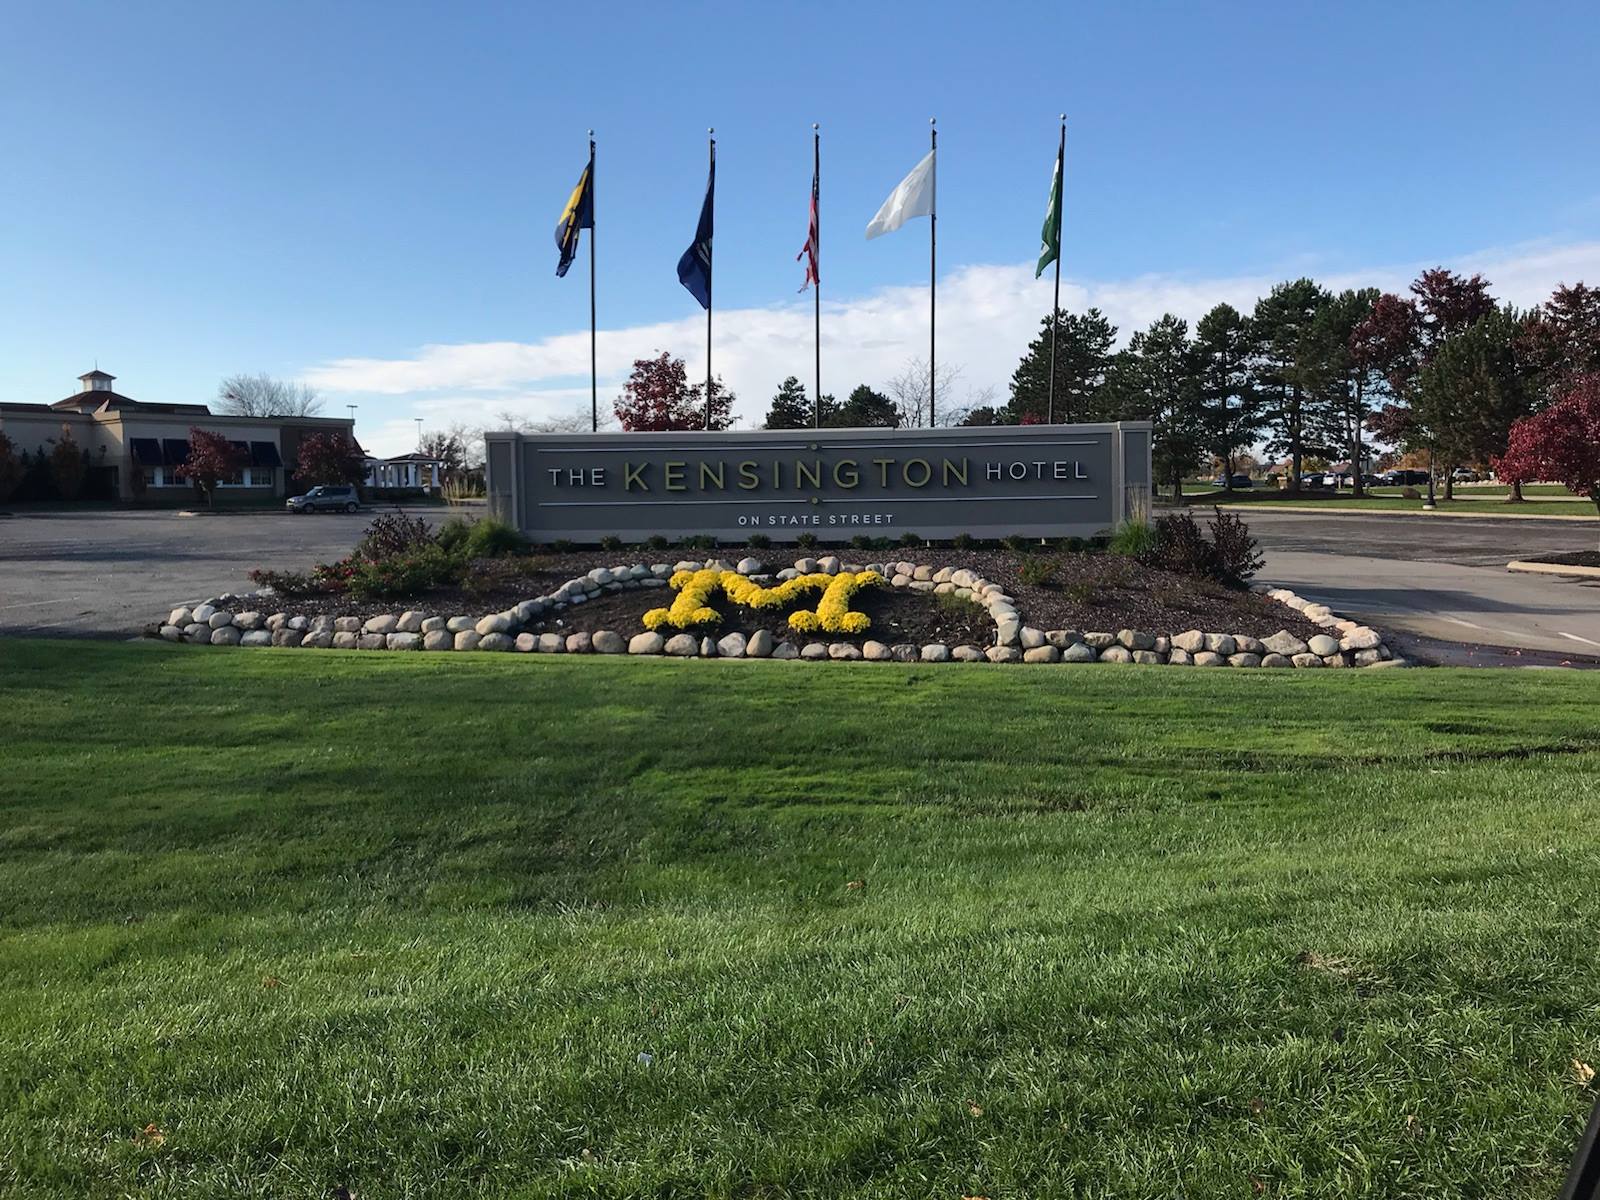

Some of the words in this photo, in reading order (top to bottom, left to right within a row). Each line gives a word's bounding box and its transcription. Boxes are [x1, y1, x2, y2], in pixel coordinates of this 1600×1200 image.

[548, 467, 605, 486] THE
[623, 457, 969, 491] KENSINGTON
[985, 460, 1088, 480] HOTEL
[737, 515, 761, 526] ON
[768, 514, 821, 526] STATE
[828, 513, 895, 525] STREET
